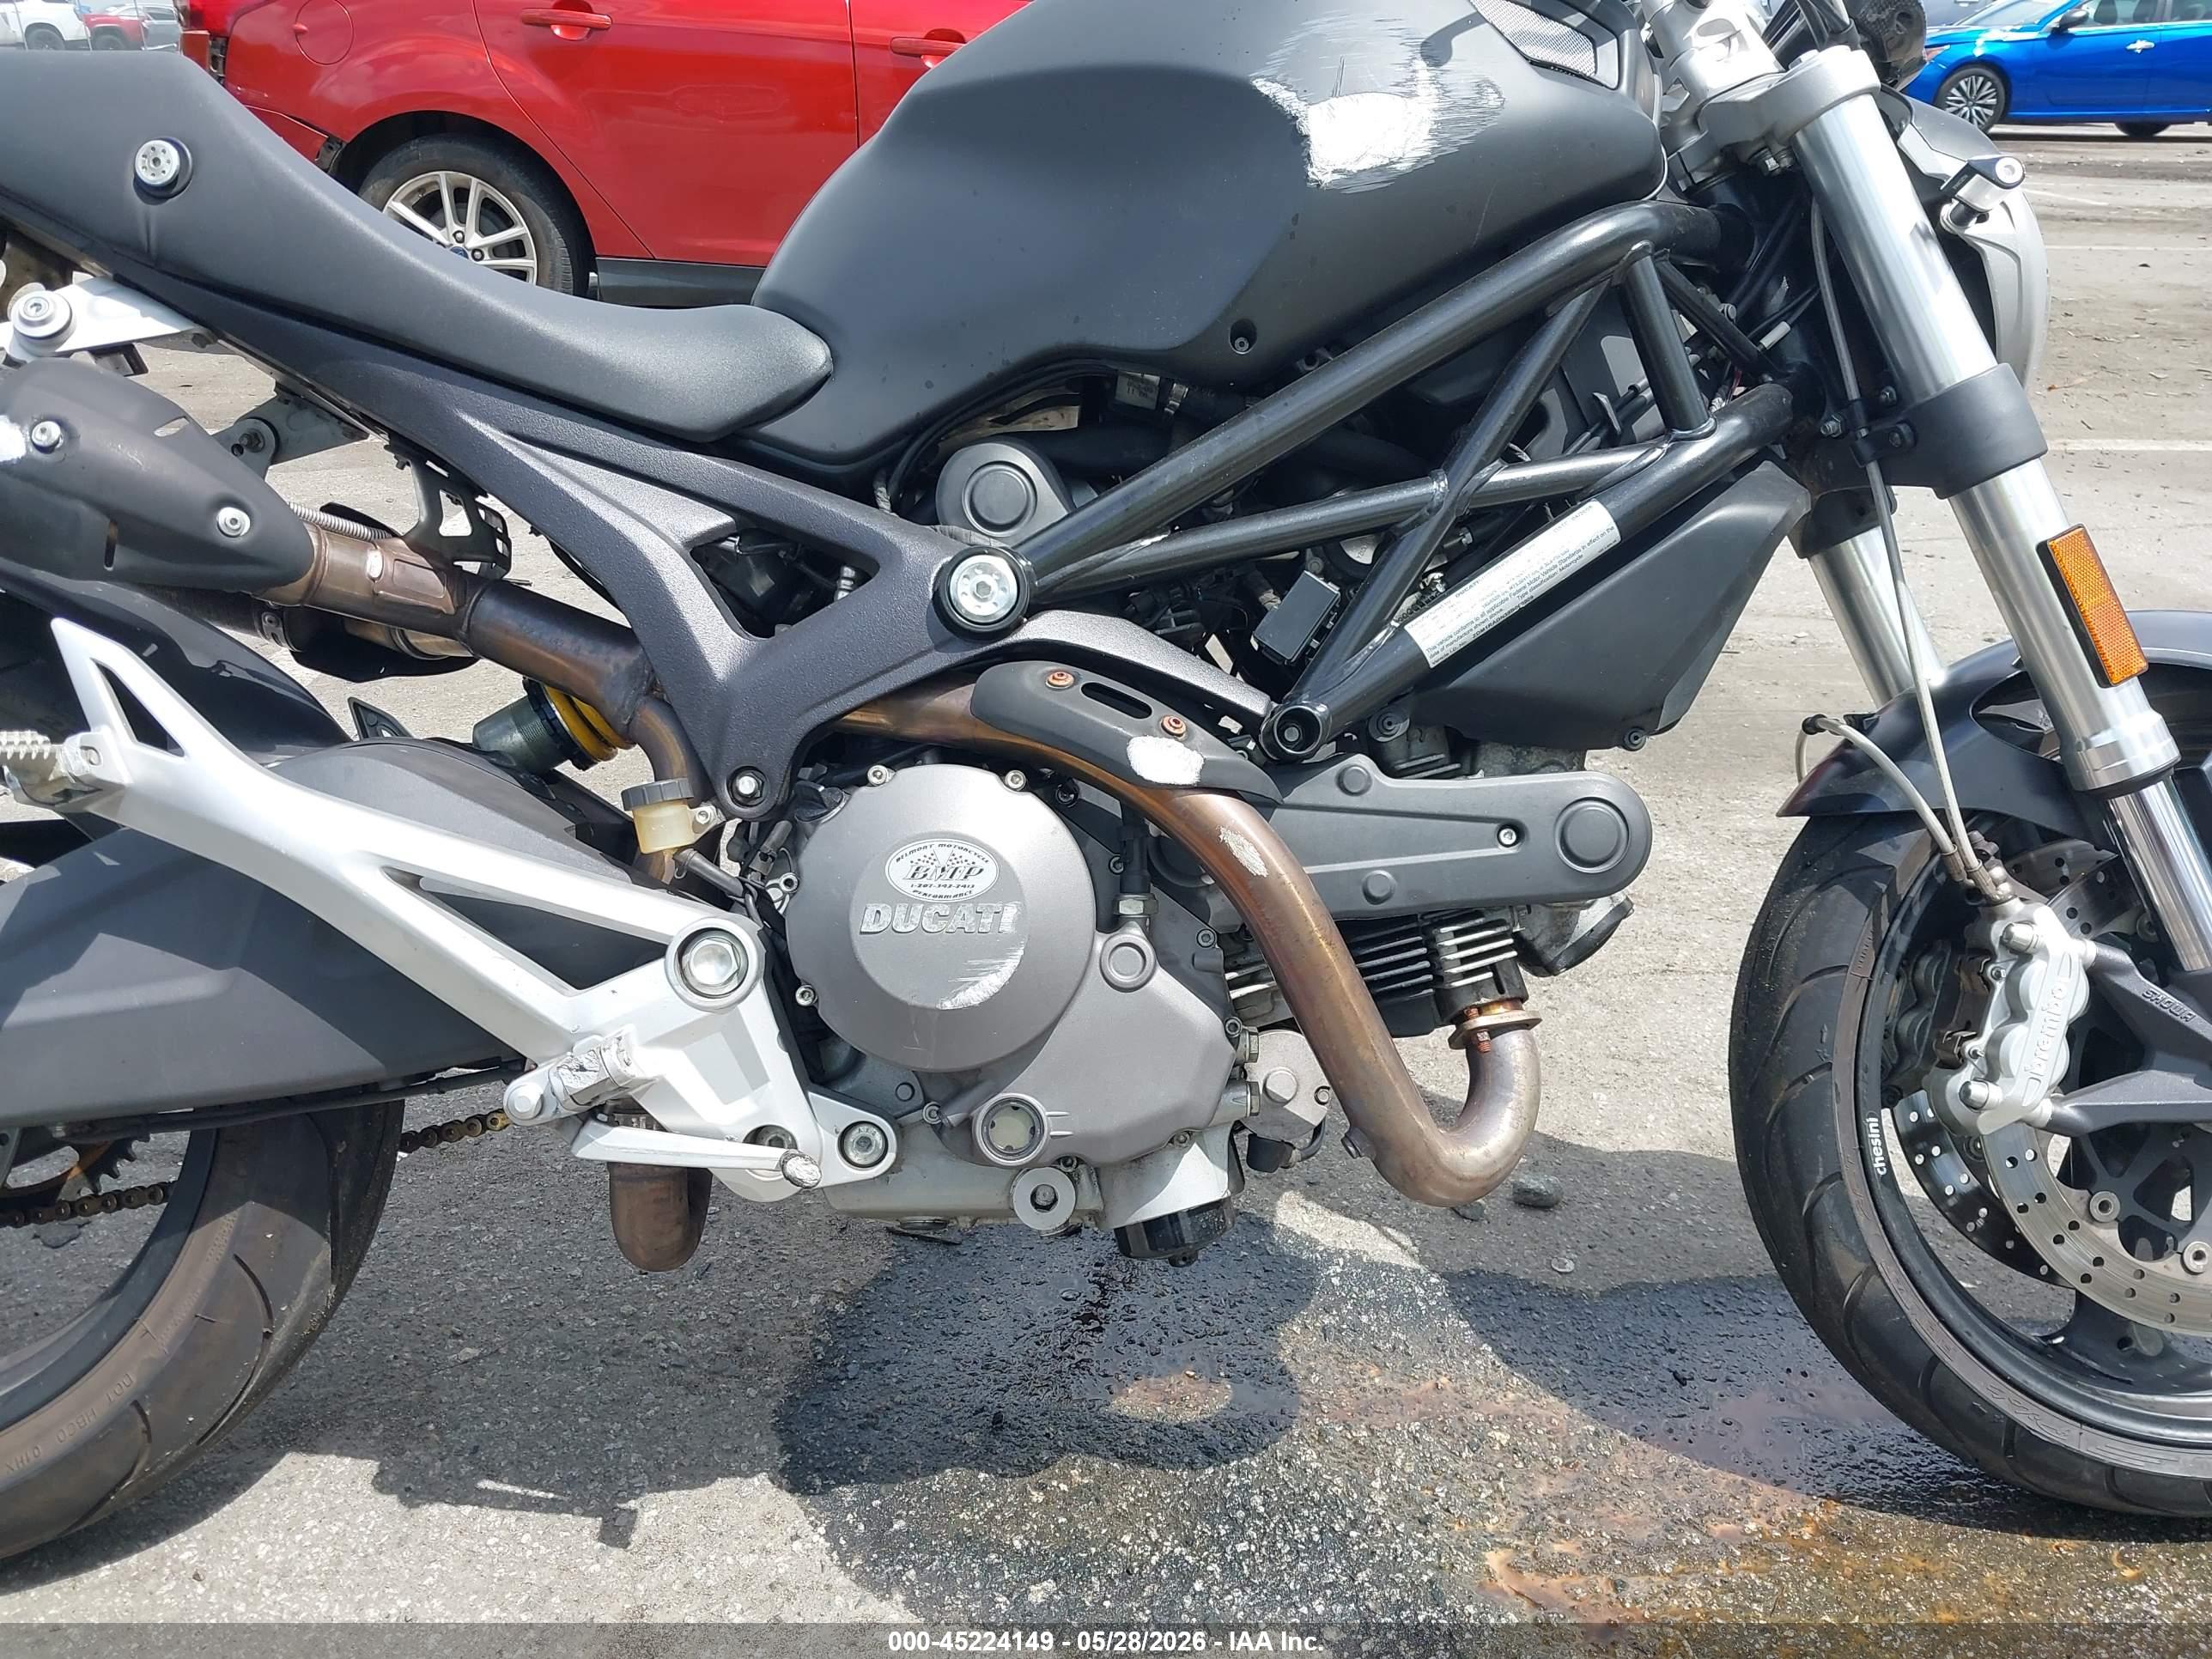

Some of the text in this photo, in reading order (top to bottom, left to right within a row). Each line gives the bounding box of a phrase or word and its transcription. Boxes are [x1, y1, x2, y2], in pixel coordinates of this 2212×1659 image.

[1425, 643, 1437, 653] This
[1435, 633, 1453, 647] vehicle
[1451, 618, 1474, 636] conforms
[1484, 595, 1510, 615] applicable
[1508, 583, 1528, 599] Federal
[1526, 574, 1541, 586] Motor
[1540, 562, 1559, 577] Vehicle
[1556, 547, 1582, 566] Standards
[1585, 534, 1601, 547] effect
[1605, 525, 1615, 533] the
[1427, 648, 1440, 659] date
[1443, 626, 1474, 648] manufacture
[1472, 617, 1489, 630] shown
[1516, 589, 1529, 601] Type
[1557, 553, 1584, 574] Motorcycle
[895, 842, 989, 864] BELMONT MOTORCYCLE
[902, 864, 984, 881] BMP
[911, 889, 973, 899] PERFORMANCE
[860, 903, 1019, 934] DUCATI
[2142, 988, 2197, 1023] SHOWA
[2023, 985, 2067, 1080] brembo
[1867, 1117, 1887, 1176] chesini
